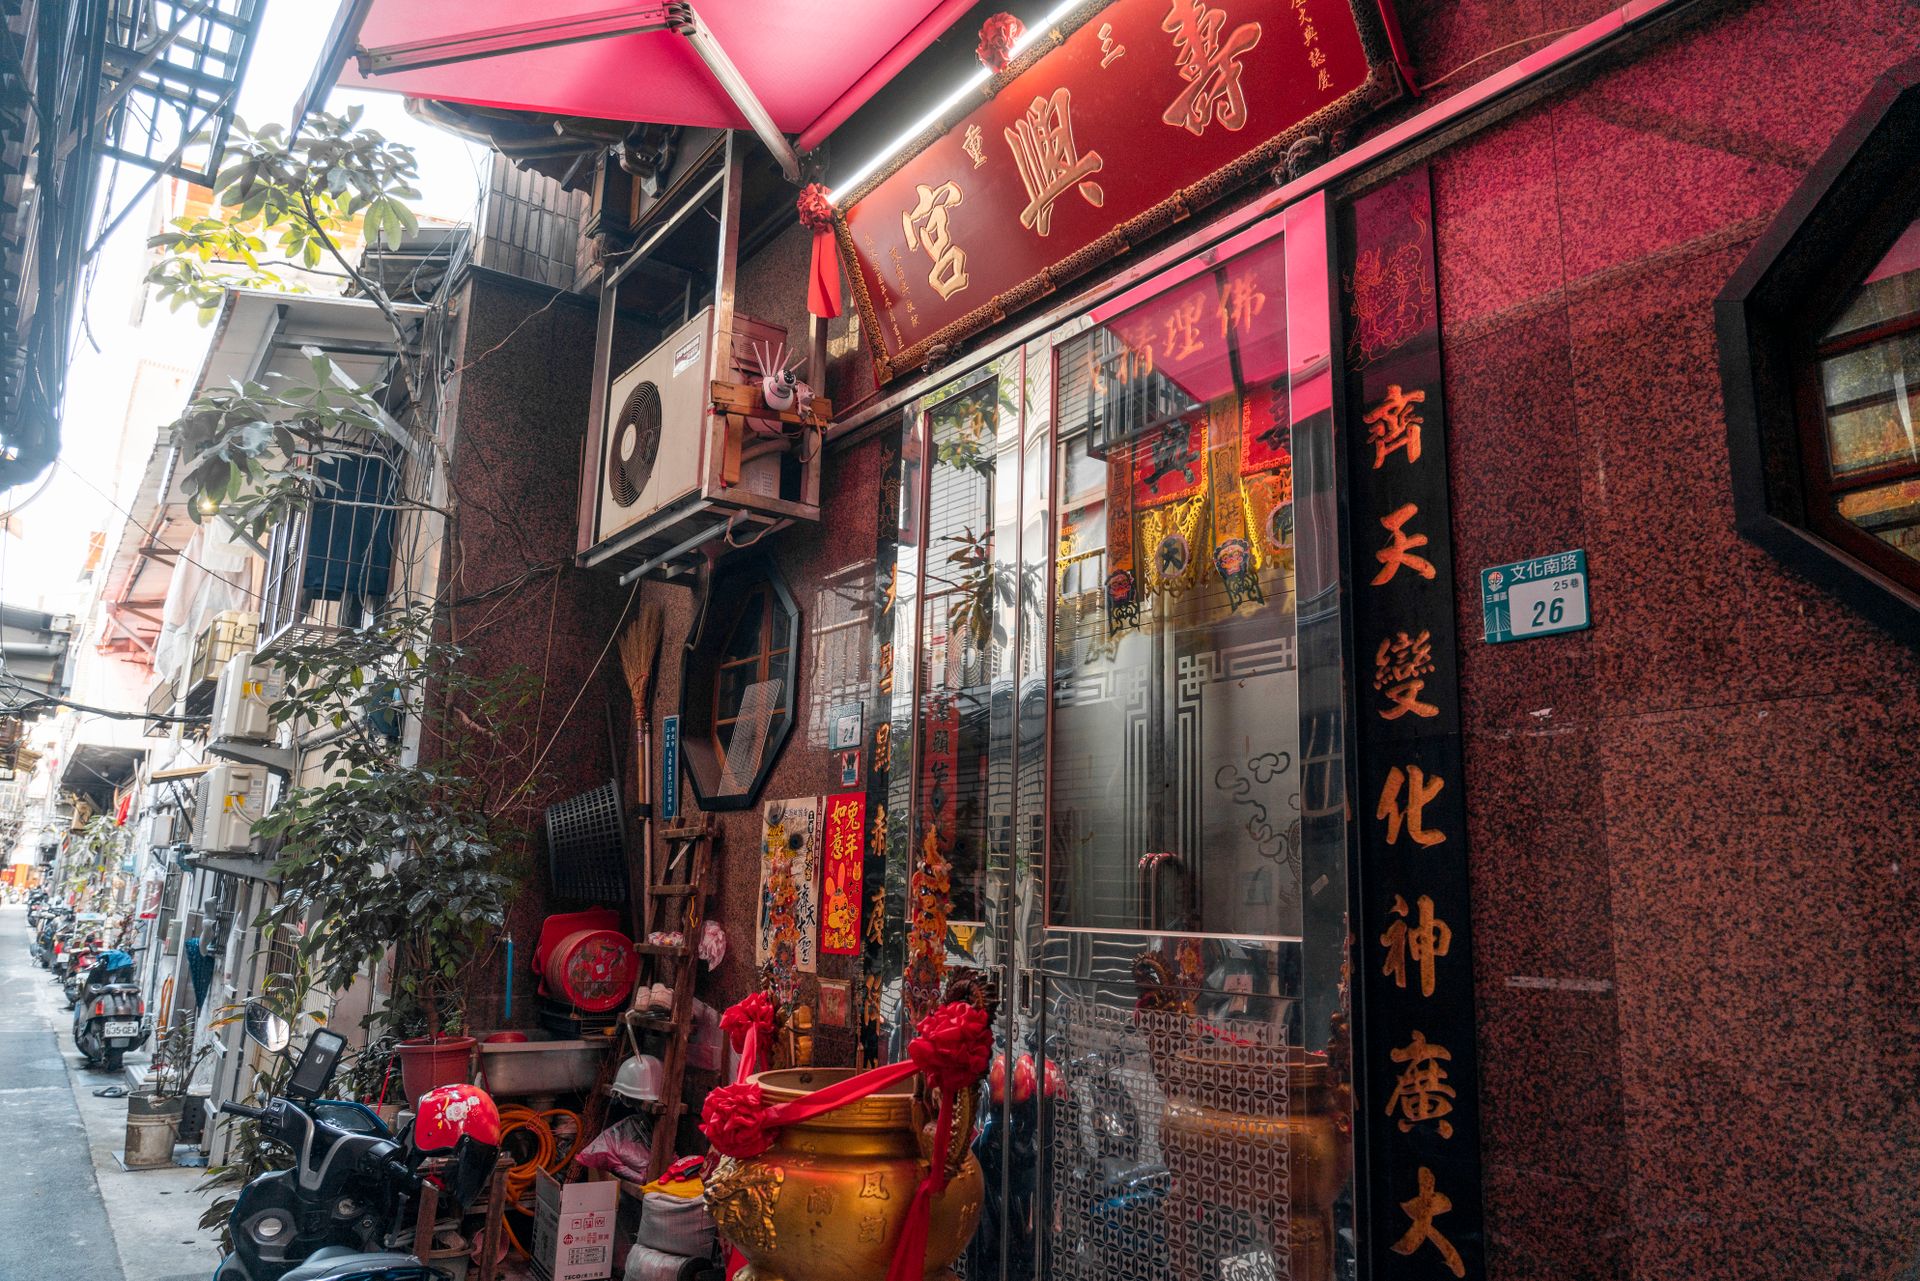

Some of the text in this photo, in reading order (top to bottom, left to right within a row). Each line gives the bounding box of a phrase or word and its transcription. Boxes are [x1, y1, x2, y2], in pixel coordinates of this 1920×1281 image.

[1510, 553, 1577, 582] 文化南路
[1531, 597, 1565, 627] 26
[829, 800, 848, 860] 如意
[845, 800, 861, 861] 兔年
